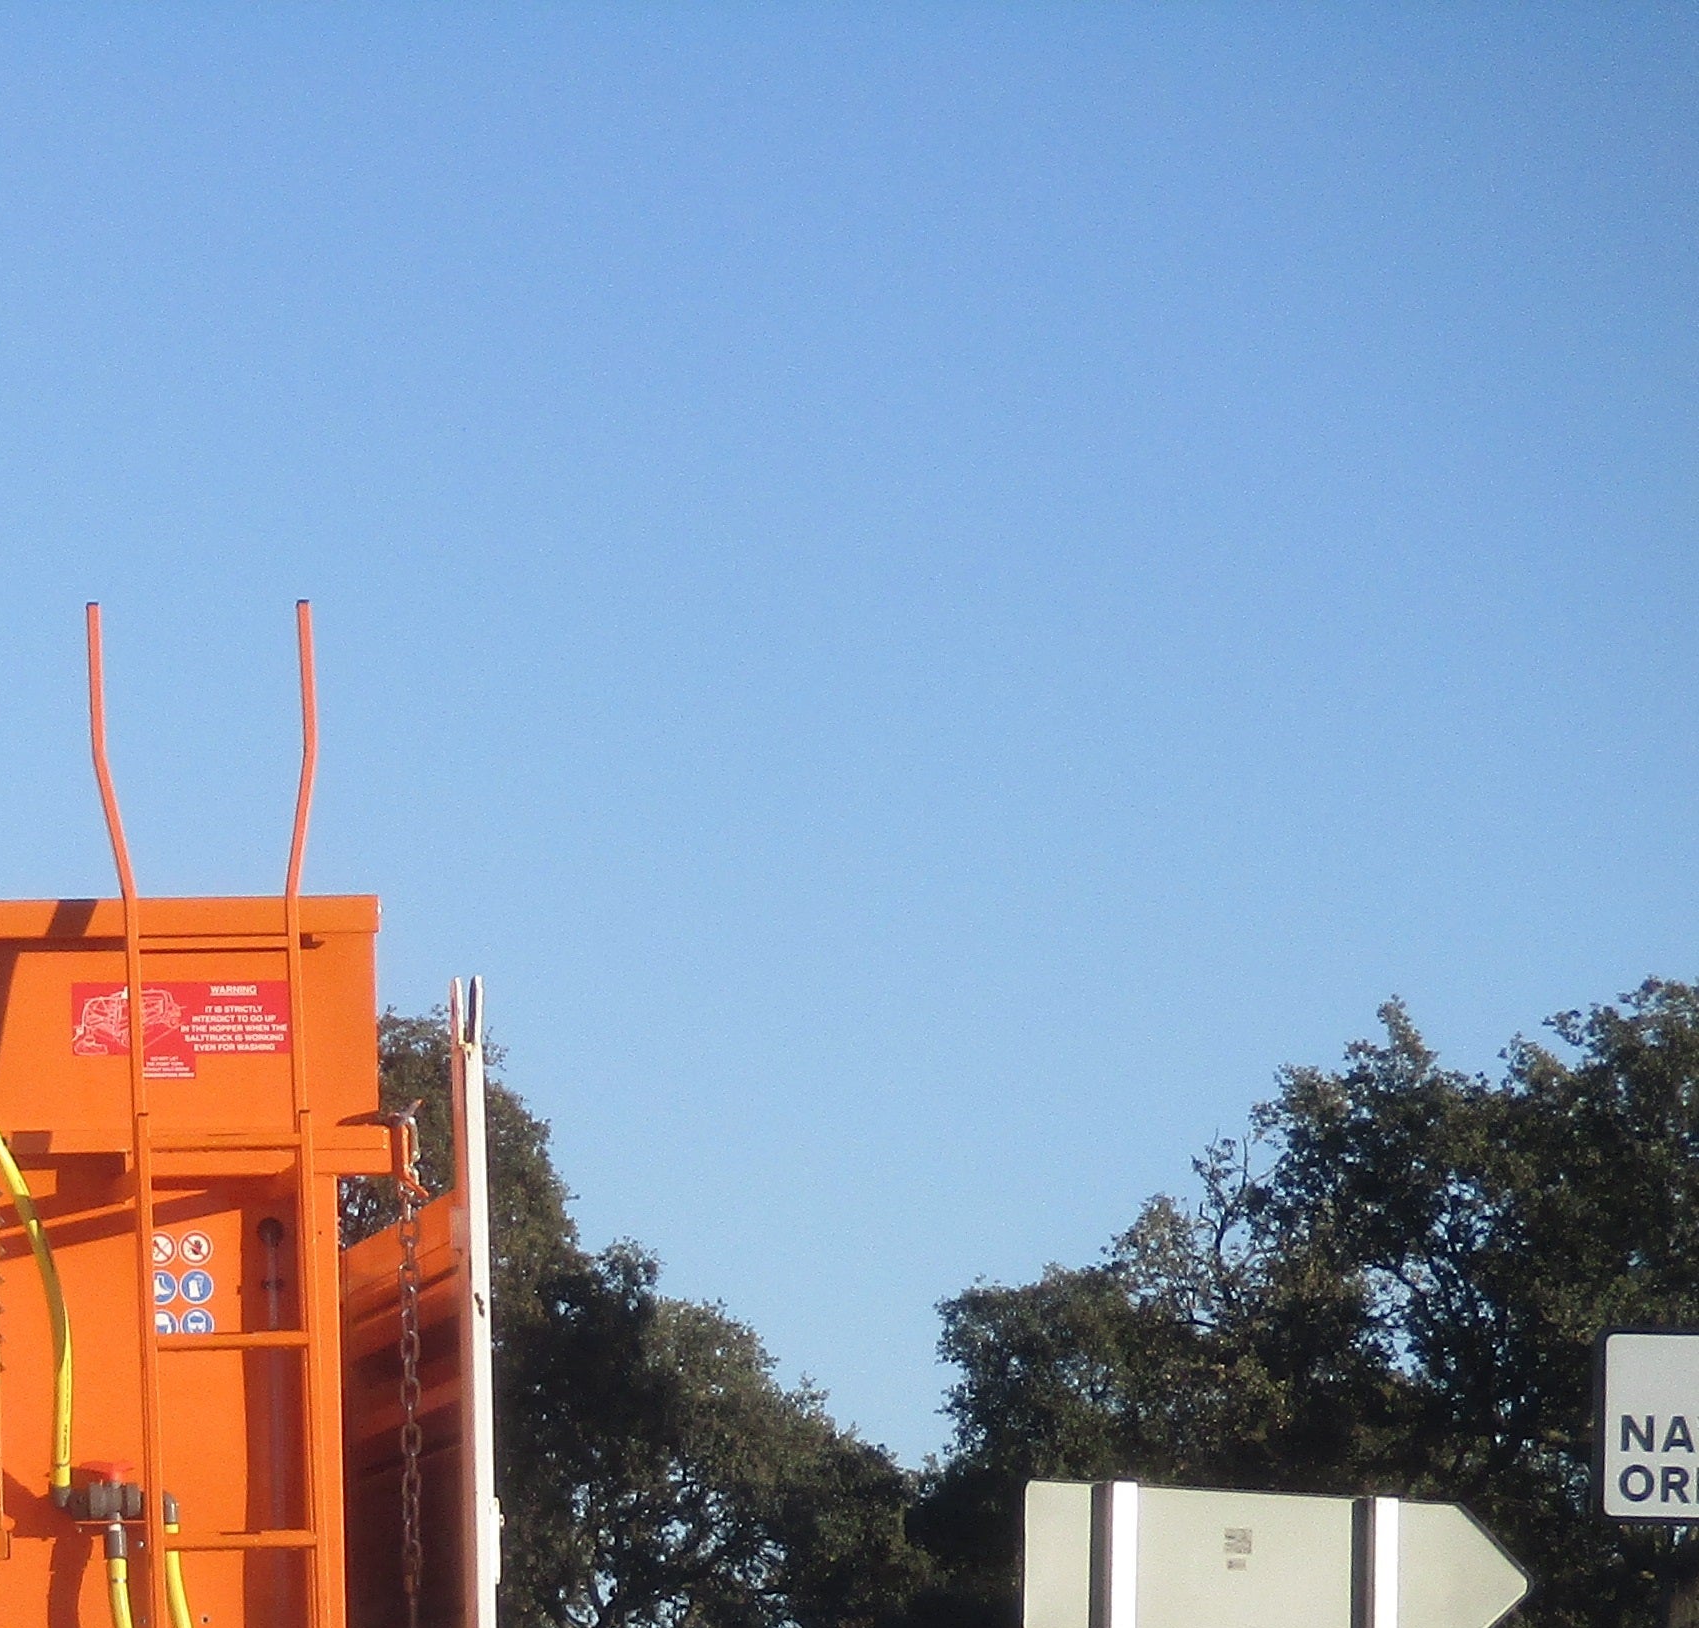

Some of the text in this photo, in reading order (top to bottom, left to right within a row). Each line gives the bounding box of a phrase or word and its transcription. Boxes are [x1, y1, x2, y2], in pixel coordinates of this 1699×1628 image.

[210, 984, 257, 995] WARNING
[224, 1005, 263, 1013] STRICTLY
[192, 1015, 235, 1023] INTERDICT
[209, 1024, 243, 1032] HOPPER
[271, 1023, 287, 1031] THE
[245, 1033, 284, 1041] WORKING
[237, 1043, 275, 1051] WASHING
[1620, 1414, 1699, 1453] NA
[1619, 1464, 1699, 1504] OR
